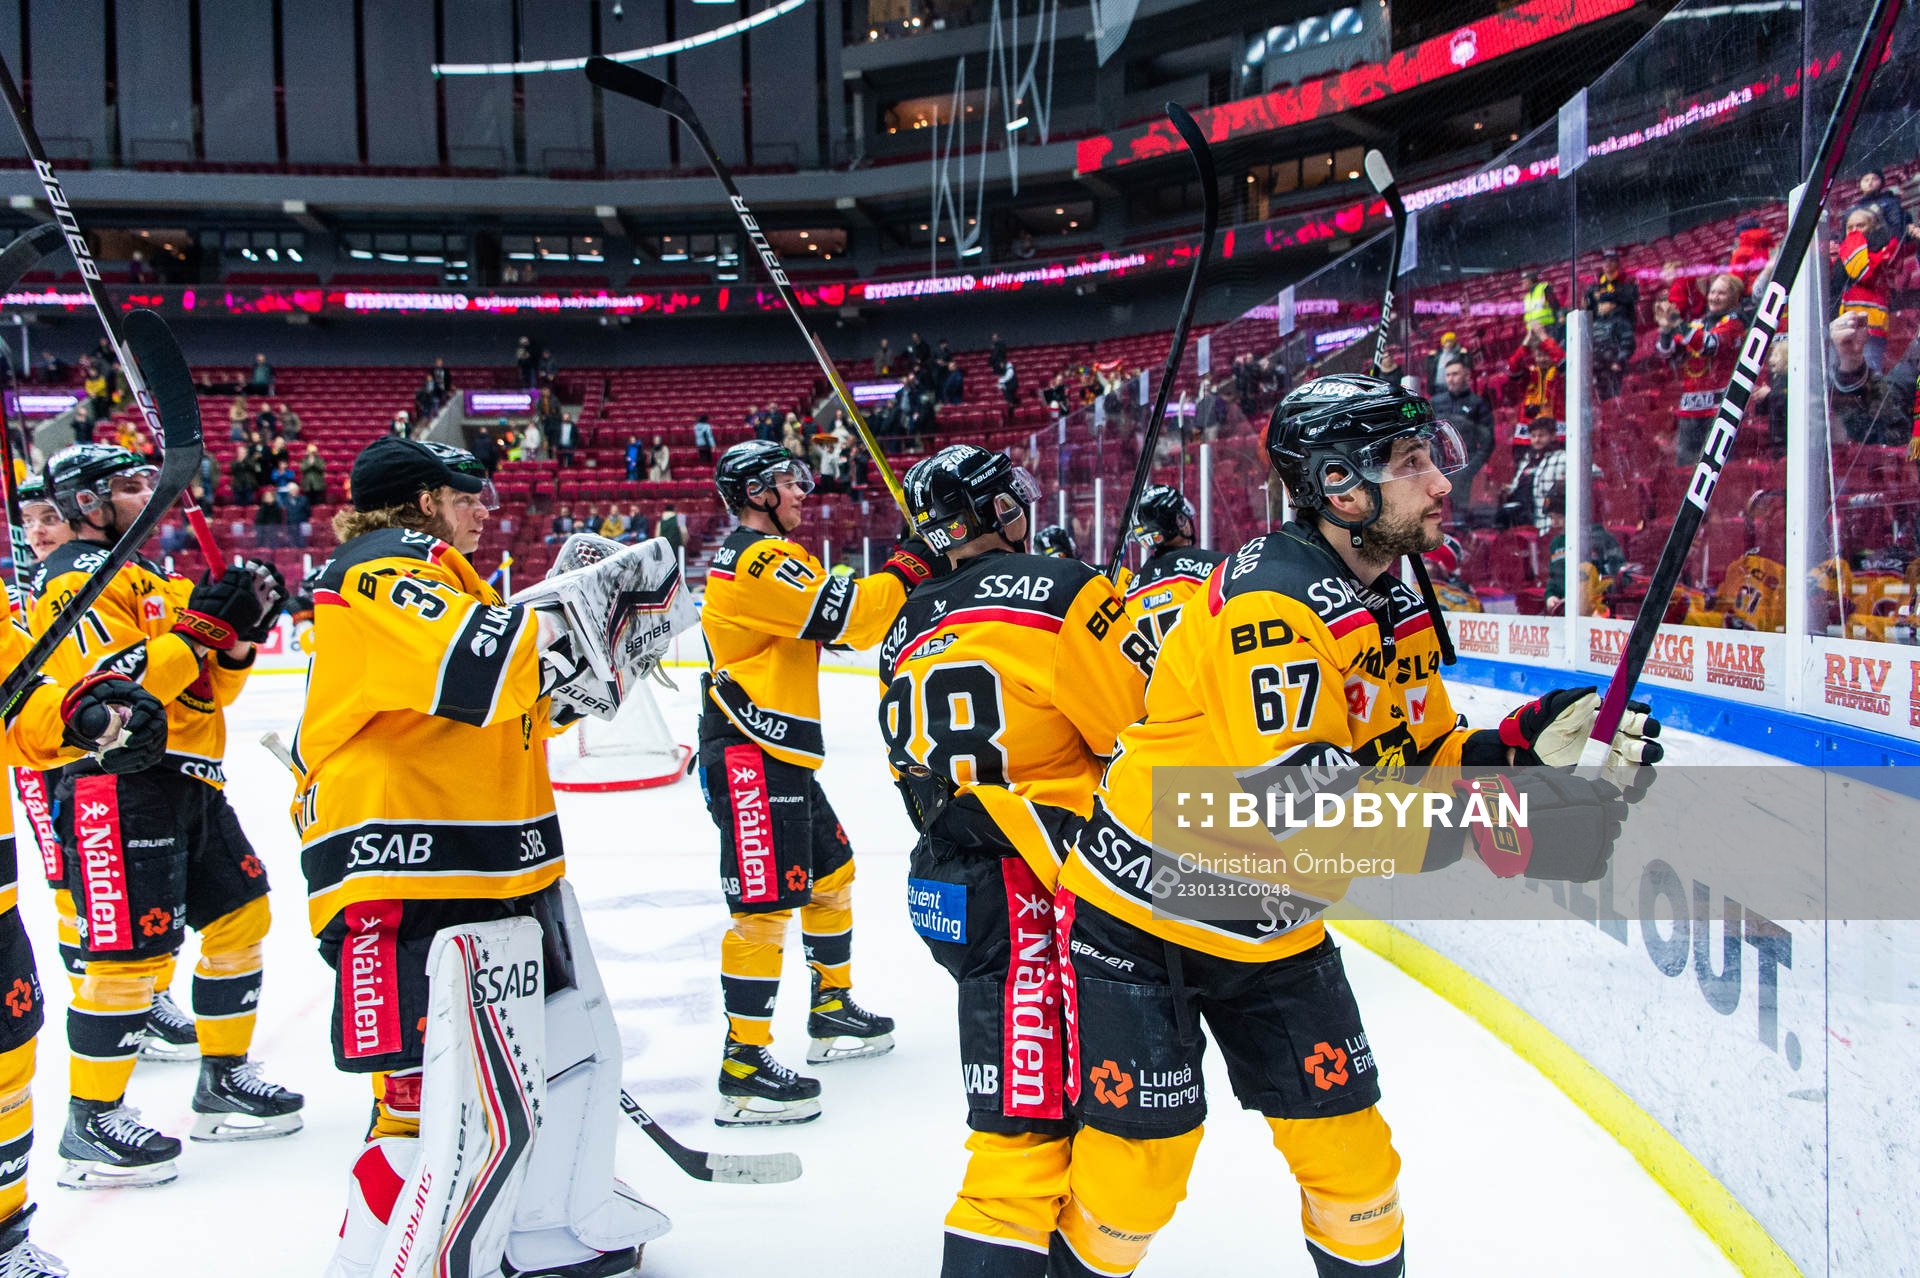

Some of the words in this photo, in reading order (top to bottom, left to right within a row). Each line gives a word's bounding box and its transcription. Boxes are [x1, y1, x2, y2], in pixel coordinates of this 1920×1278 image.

[33, 158, 101, 281] BAUER
[730, 194, 790, 287] BAUER
[1374, 290, 1396, 368] BAUER
[1688, 281, 1788, 513] BAUER
[970, 466, 998, 487] BAUER
[928, 528, 952, 550] 88
[774, 558, 816, 592] 14
[1174, 558, 1214, 577] SSAB
[974, 574, 1054, 602] SSAB
[625, 620, 671, 654] BAUER
[1458, 619, 1499, 642] BYGG
[1508, 622, 1549, 645] MARK
[1652, 633, 1694, 663] YGG
[1706, 641, 1765, 673] MARK
[1824, 653, 1892, 692] RIV
[1250, 659, 1320, 736] 67
[738, 702, 789, 741] SSAB
[879, 660, 1016, 793] 88
[768, 795, 804, 804] BAUER
[127, 837, 175, 848] BAUER
[347, 833, 433, 868] SSAB
[1090, 827, 1181, 900] SSAB
[1070, 940, 1136, 972] BAUER
[473, 960, 539, 1008] SSAB
[1140, 1063, 1192, 1087] Luleå
[1097, 1224, 1153, 1242] BAUER
